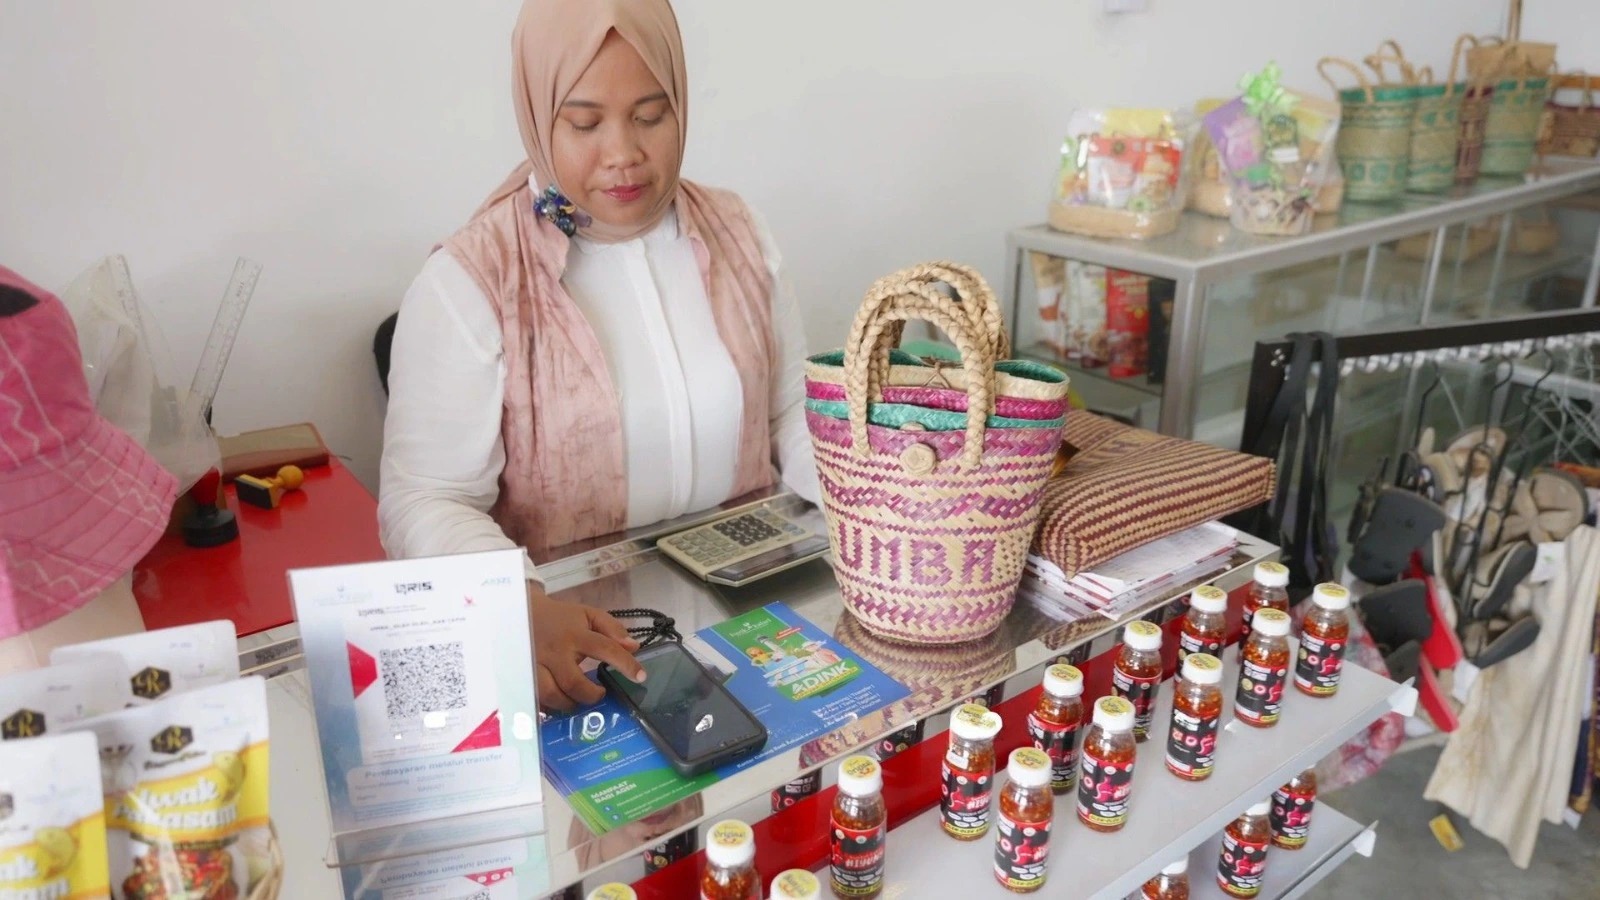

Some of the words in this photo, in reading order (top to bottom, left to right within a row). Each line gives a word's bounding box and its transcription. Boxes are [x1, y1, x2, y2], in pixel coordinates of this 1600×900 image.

[837, 520, 997, 587] UMBA
[395, 582, 432, 595] QRIS
[792, 661, 851, 694] ADINK
[365, 765, 426, 778] Pembayaran
[429, 758, 464, 769] melalui
[465, 753, 503, 764] transfer
